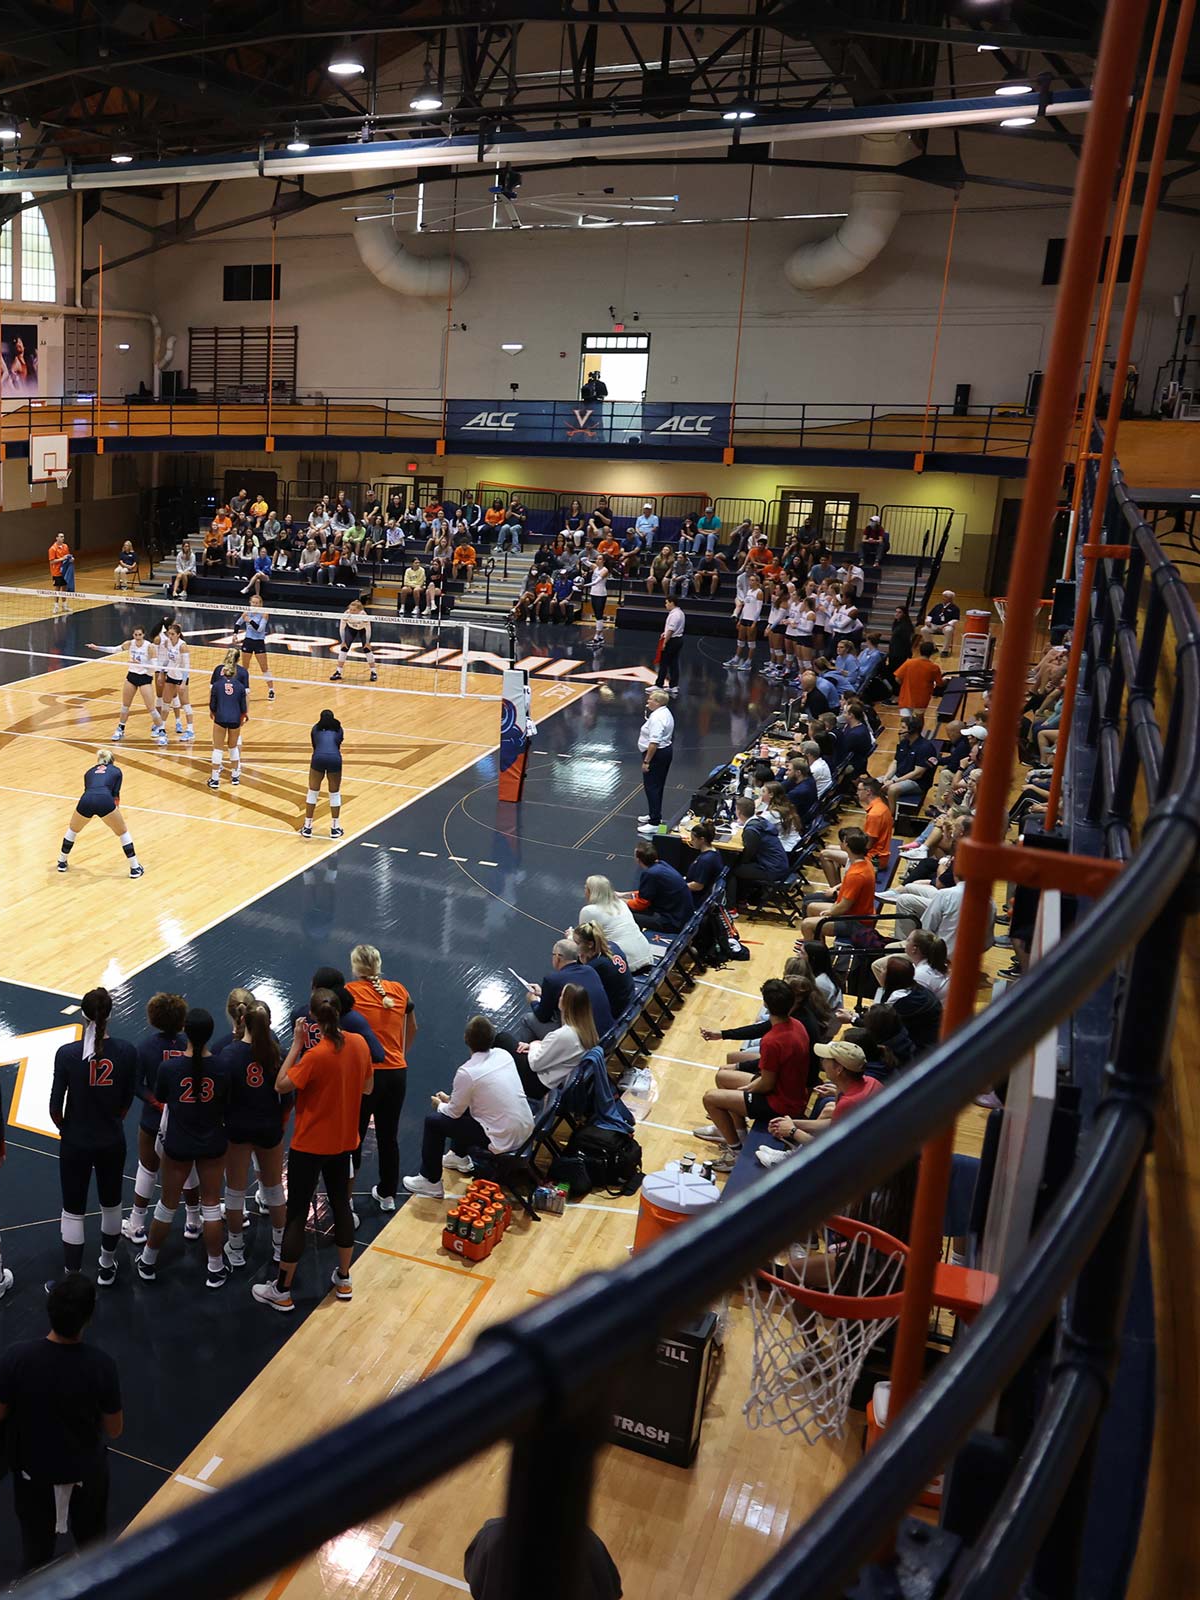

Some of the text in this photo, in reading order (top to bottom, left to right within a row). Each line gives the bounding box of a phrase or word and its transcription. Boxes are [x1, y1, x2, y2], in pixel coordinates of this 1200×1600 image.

[465, 412, 520, 428] ACC
[655, 415, 716, 432] ACC
[224, 684, 234, 696] 5
[94, 764, 107, 774] 2
[612, 954, 627, 974] 3
[90, 1058, 114, 1086] 12
[246, 1062, 264, 1088] 8
[179, 1077, 215, 1103] 23
[453, 1240, 464, 1252] G
[613, 1415, 670, 1444] TRASH
